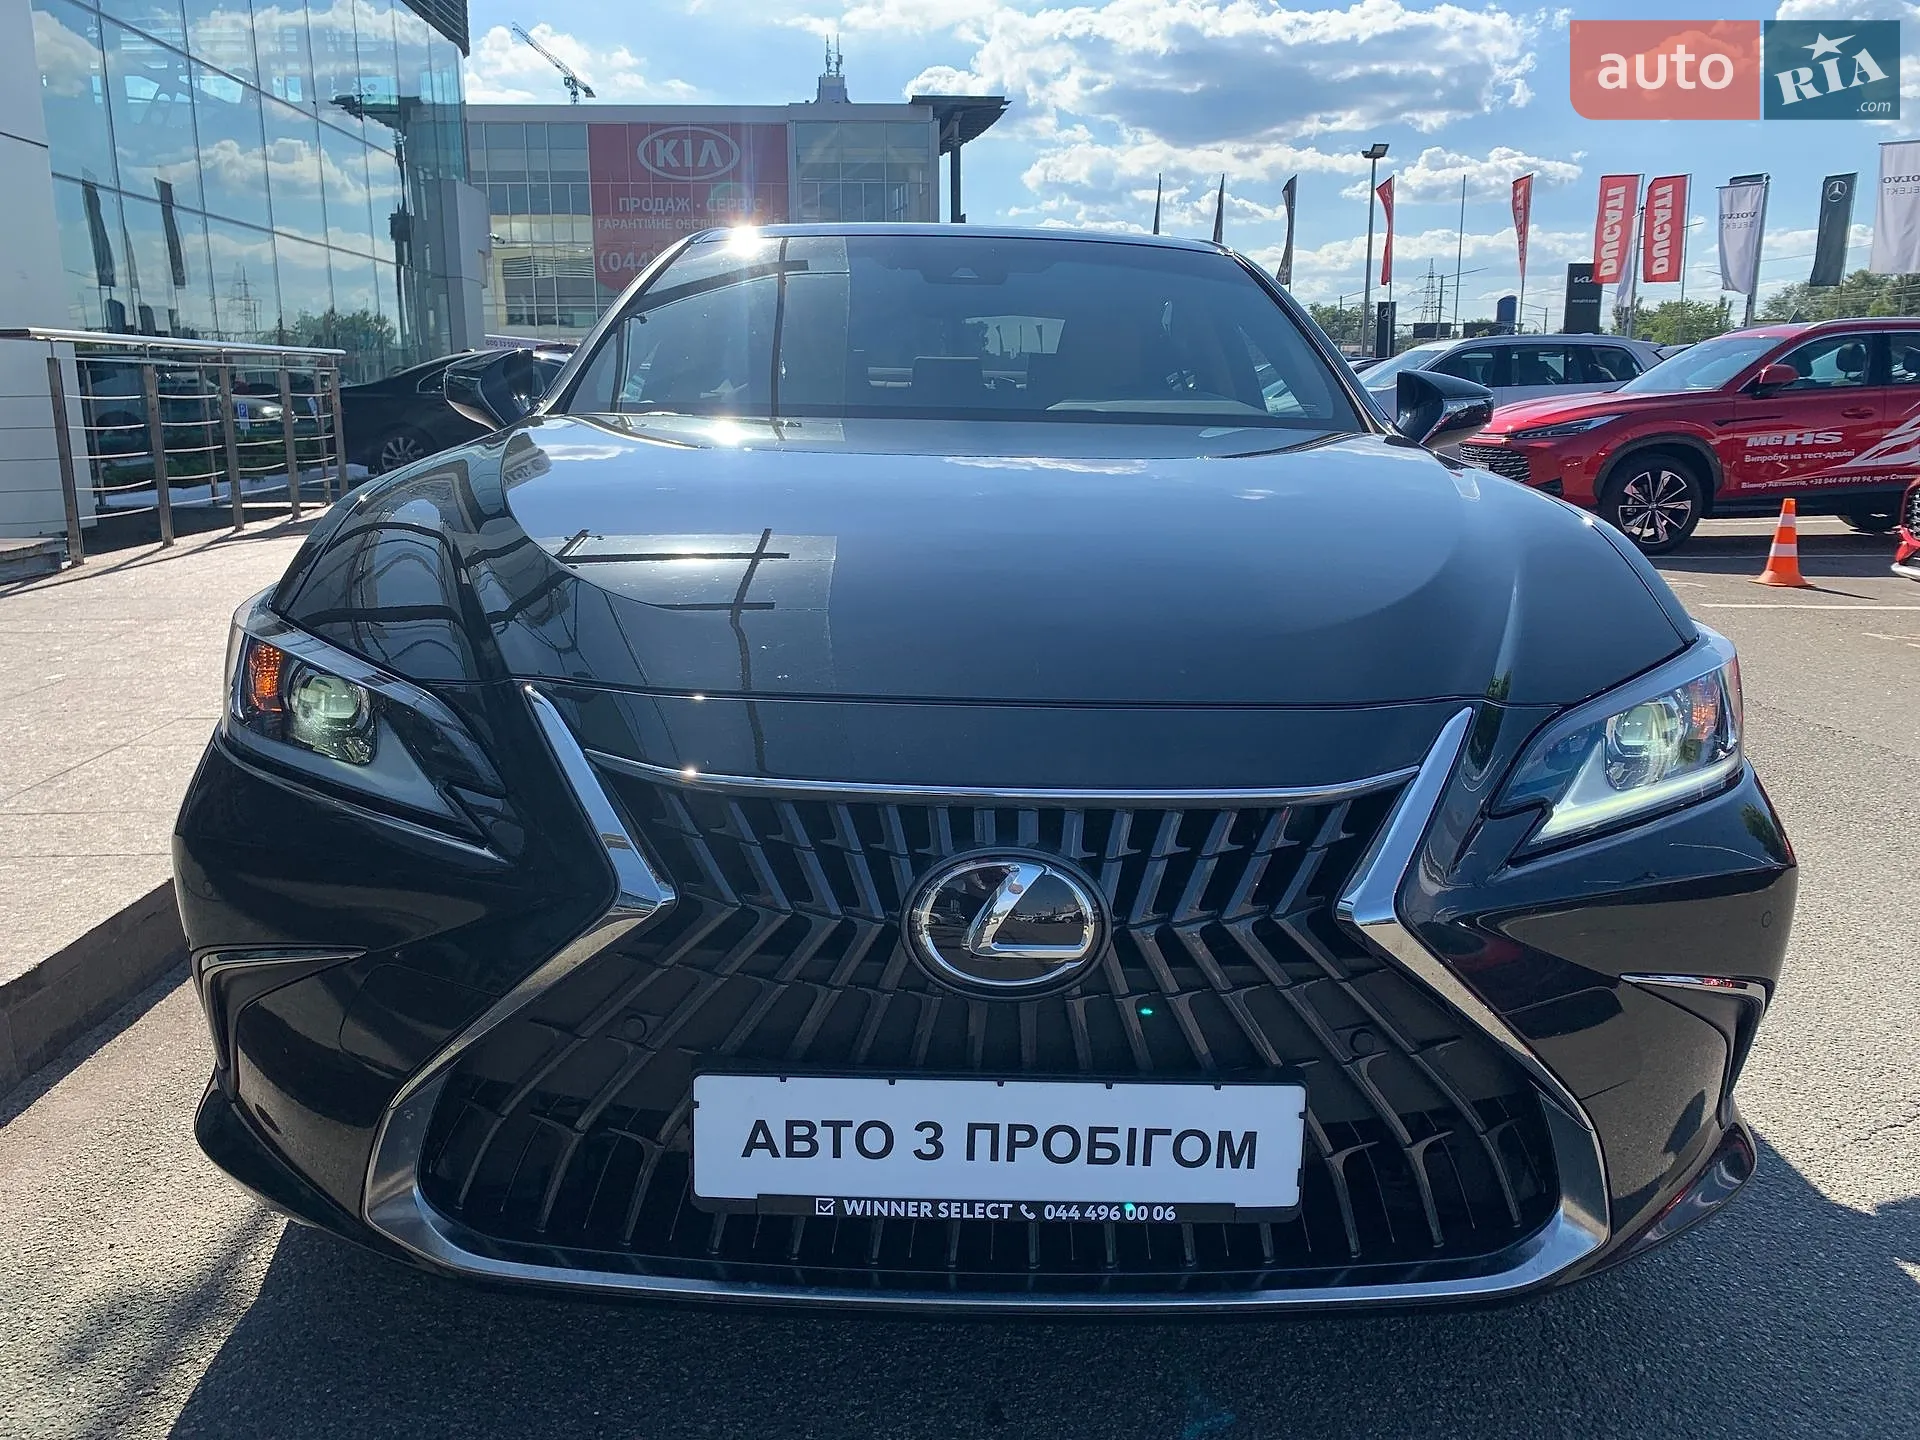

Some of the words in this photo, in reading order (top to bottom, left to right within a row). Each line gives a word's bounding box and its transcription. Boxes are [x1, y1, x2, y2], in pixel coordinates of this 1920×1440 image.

[655, 139, 723, 168] KIA
[618, 197, 690, 215] ПРОДАЖ
[741, 1119, 895, 1159] АВТО
[966, 1122, 1257, 1169] ПРОБІГОМ
[843, 1199, 933, 1218] WINNER
[938, 1202, 1012, 1219] SELECT
[1044, 1204, 1080, 1220] 044
[1085, 1205, 1121, 1221] 496
[1125, 1203, 1148, 1221] 00
[1153, 1205, 1176, 1221] 06
